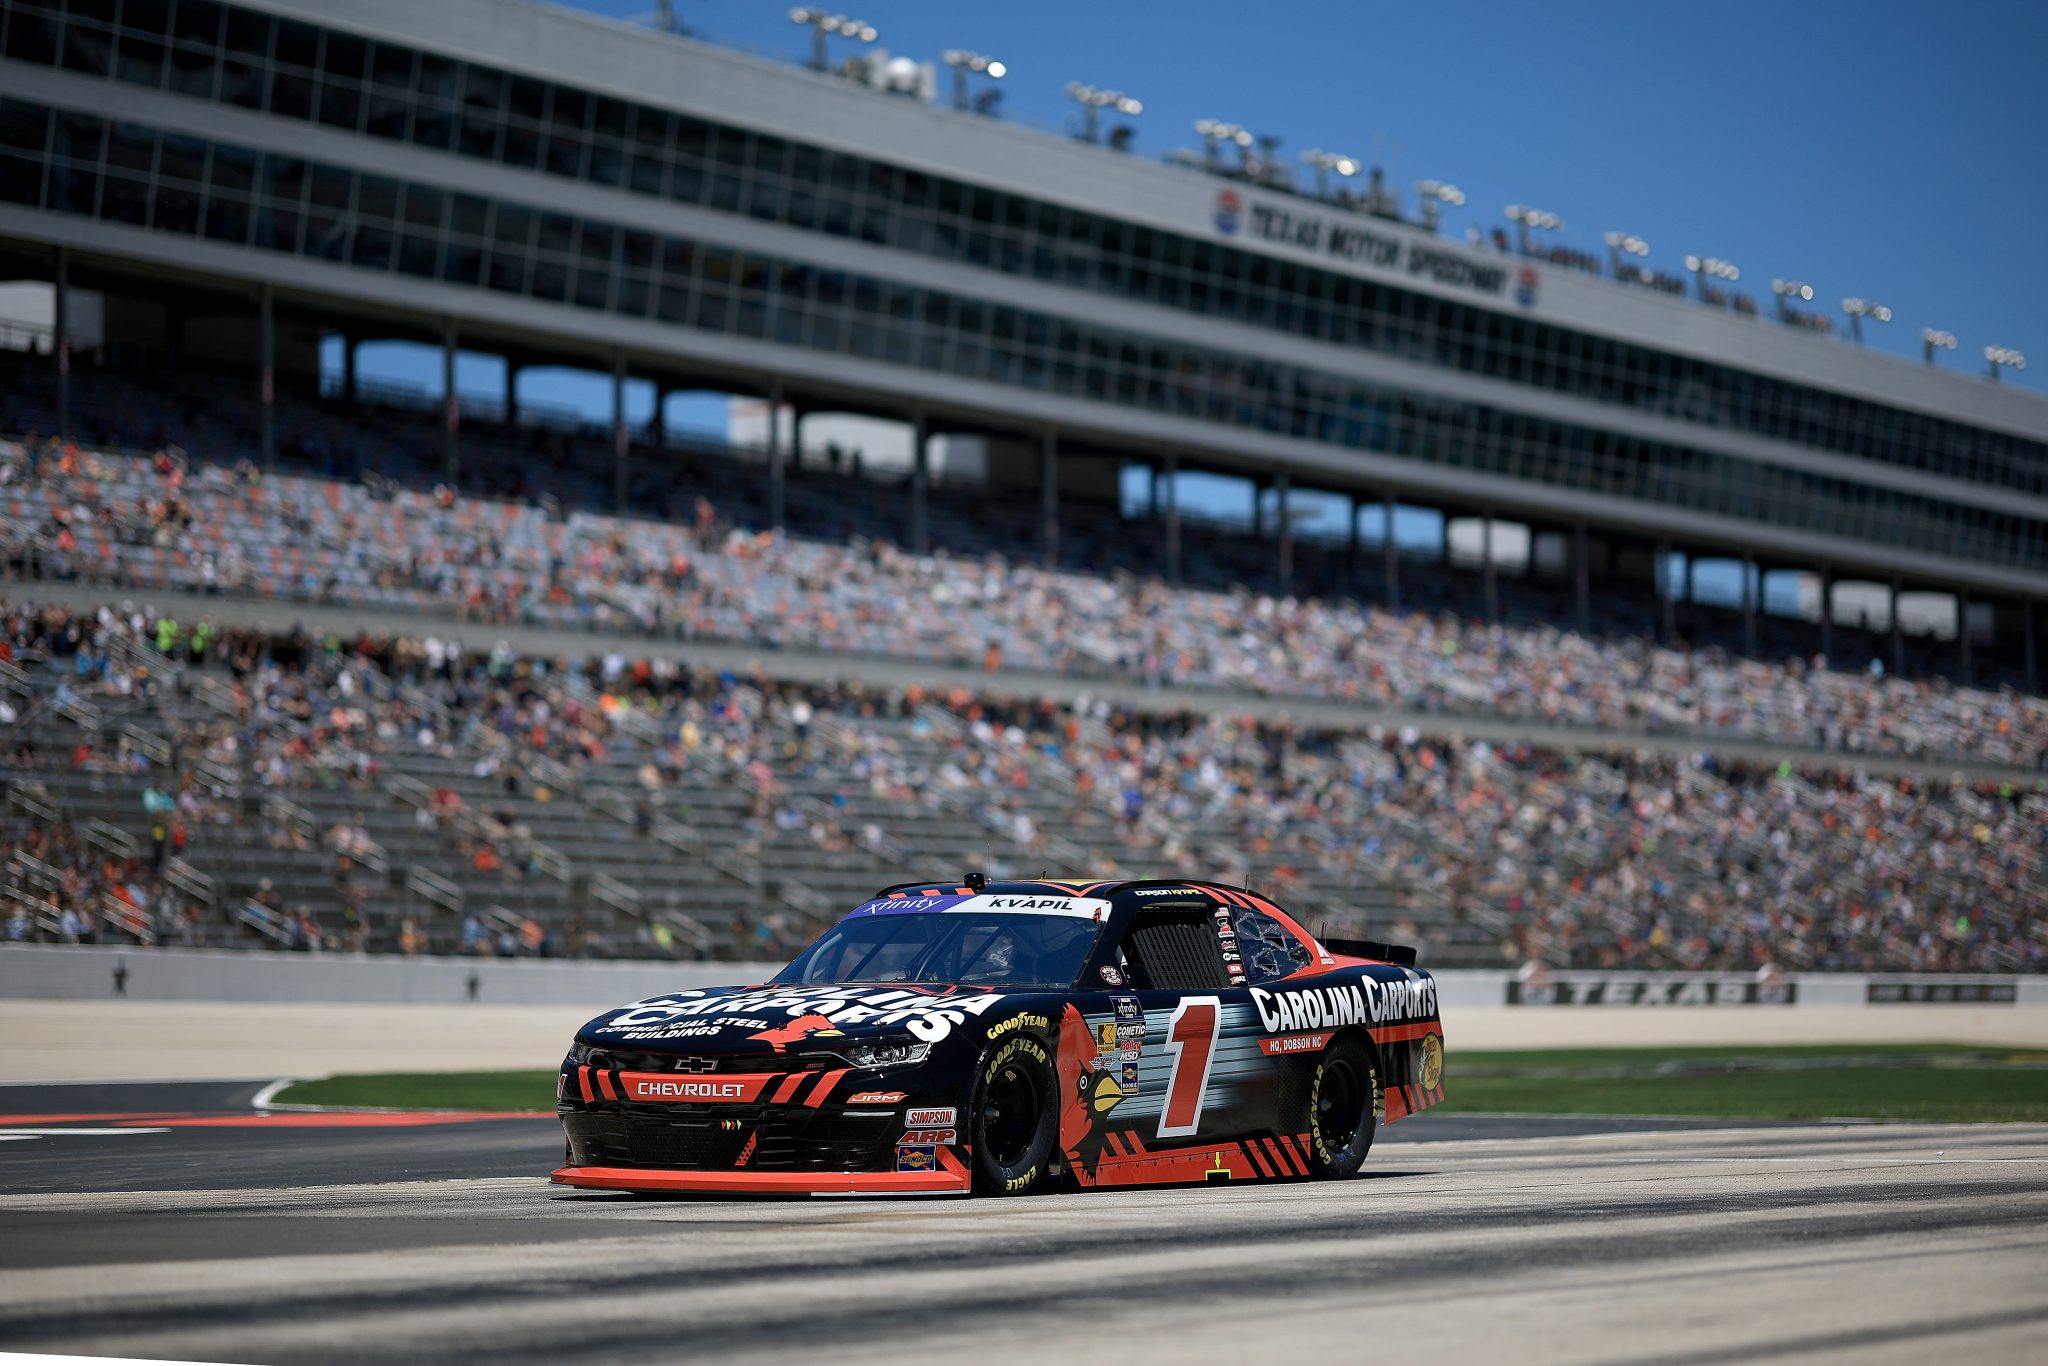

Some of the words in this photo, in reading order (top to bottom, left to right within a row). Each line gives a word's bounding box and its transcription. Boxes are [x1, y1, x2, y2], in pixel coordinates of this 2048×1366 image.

[1252, 203, 1320, 249] TEXAS
[1328, 225, 1399, 268] MOTOR
[1408, 242, 1507, 295] SPEEDWAY
[863, 897, 945, 914] xfinity
[988, 898, 1074, 911] KVAPIL
[1569, 981, 1750, 1006] TEXAS
[1249, 985, 1366, 1033] CAROLINA
[1361, 974, 1436, 1023] CARPORTS
[594, 1018, 708, 1034] COMMERCIAL
[712, 1016, 769, 1030] STEEL
[609, 996, 965, 1043] CARPORTS
[986, 1011, 1049, 1040] GOODYEAR
[622, 1025, 723, 1041] BUILDINGS
[1116, 1024, 1146, 1037] COMETIC
[1269, 1040, 1283, 1053] HQ,
[1283, 1037, 1311, 1051] DOBSON
[1311, 1036, 1322, 1049] NC
[985, 1037, 1047, 1086] GOODYEAR
[1120, 1051, 1139, 1061] MSD
[1156, 996, 1222, 1139] 1
[637, 1082, 745, 1098] CHEVROLET
[851, 1094, 900, 1103] JRM
[909, 1110, 953, 1125] SIMPSON
[898, 1130, 956, 1144] ARP
[900, 1154, 934, 1165] SUNOCO
[1005, 1165, 1037, 1191] EAGLE
